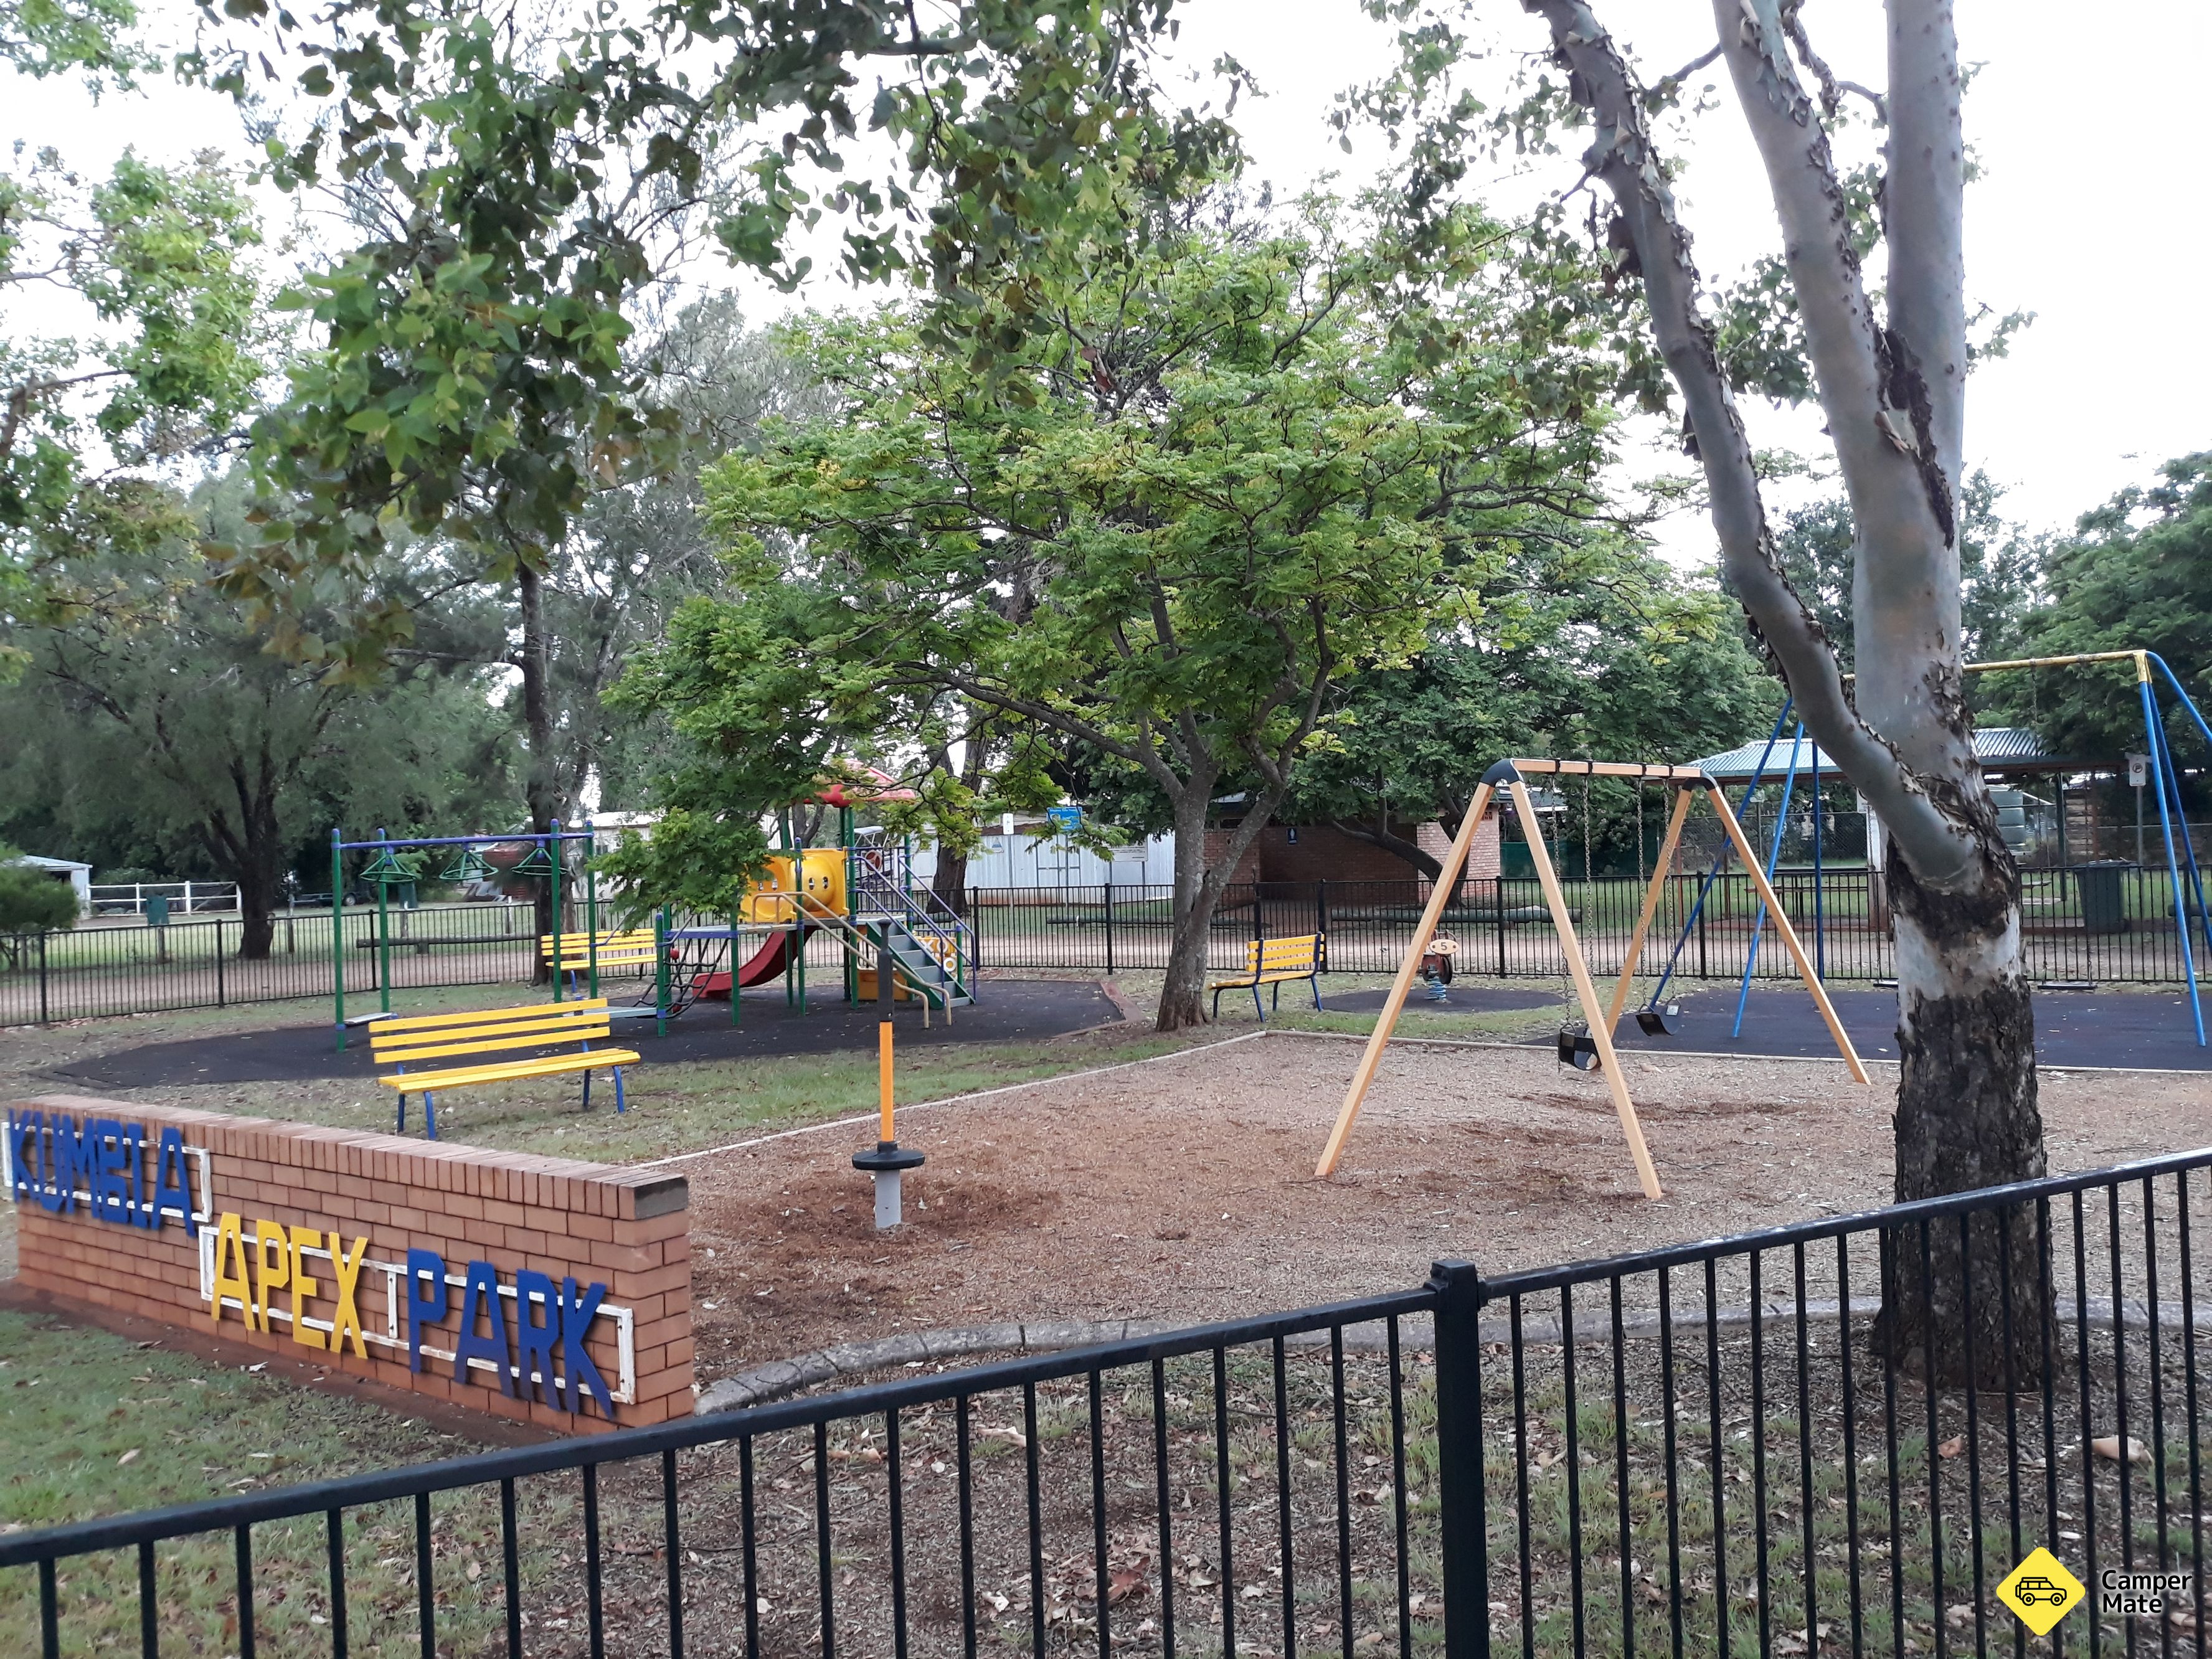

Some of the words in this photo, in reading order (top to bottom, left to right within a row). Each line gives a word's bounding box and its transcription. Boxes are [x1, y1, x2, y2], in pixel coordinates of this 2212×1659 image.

[1440, 942, 1447, 950] 5
[9, 1108, 198, 1238] KUMBIA
[211, 1212, 369, 1359] APEX
[407, 1247, 614, 1419] PARK
